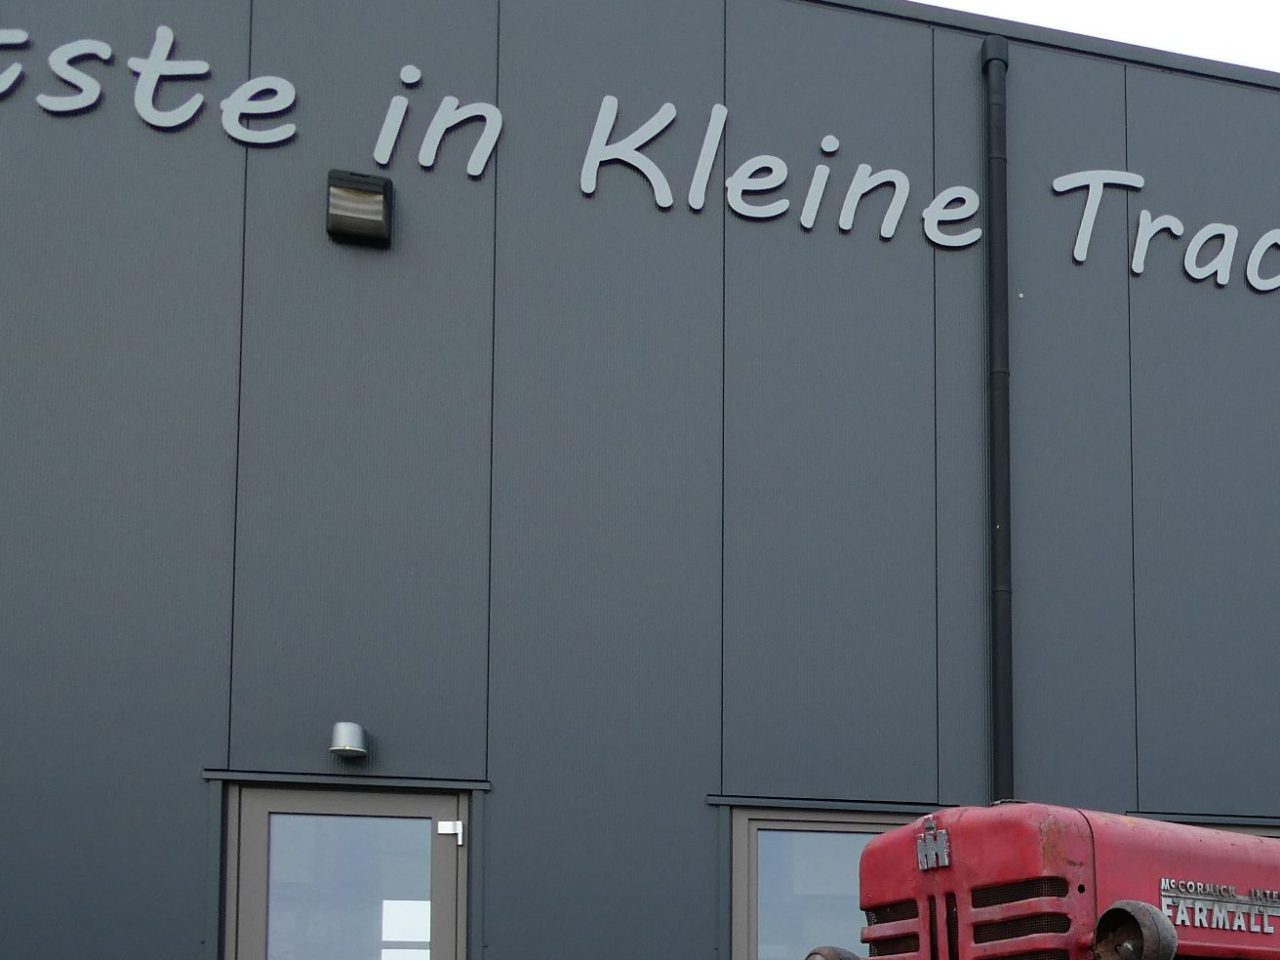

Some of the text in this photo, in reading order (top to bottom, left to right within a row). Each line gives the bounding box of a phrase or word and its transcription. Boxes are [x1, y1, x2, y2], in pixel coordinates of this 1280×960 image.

[373, 65, 503, 176] in
[581, 95, 982, 247] Kleine
[1161, 896, 1274, 933] FARMALL
